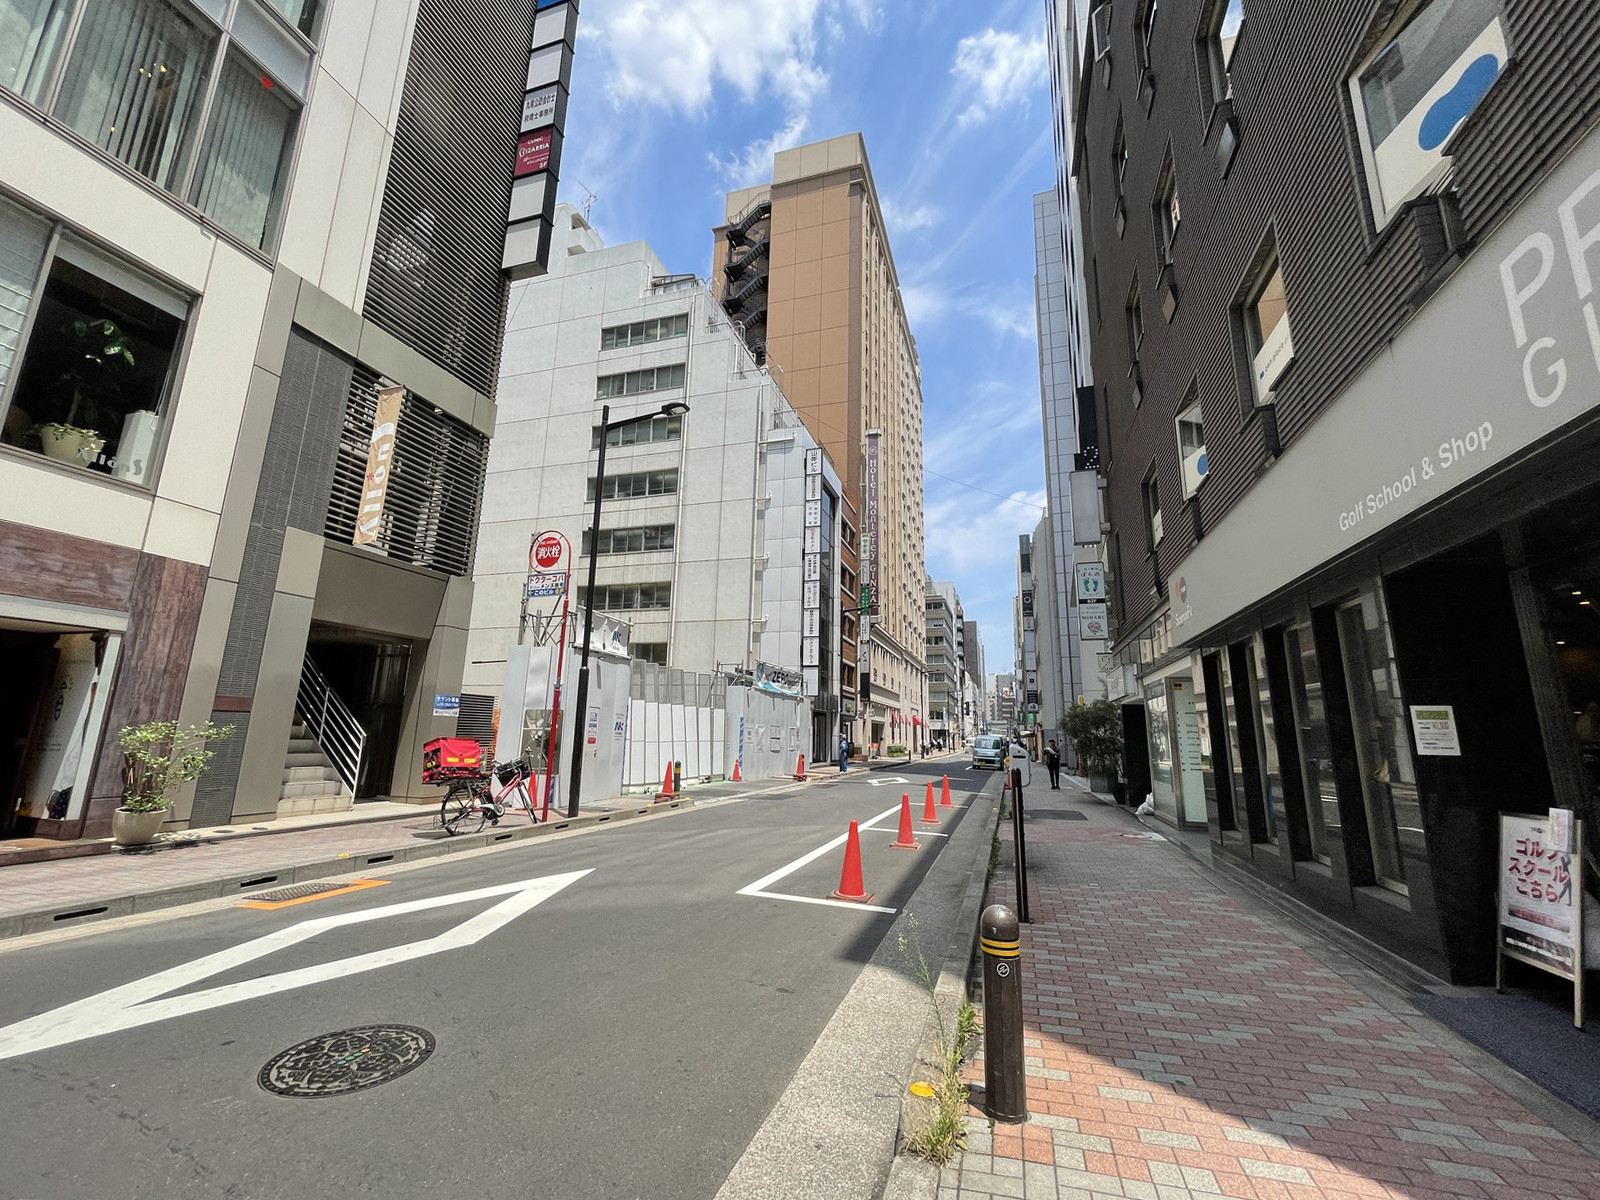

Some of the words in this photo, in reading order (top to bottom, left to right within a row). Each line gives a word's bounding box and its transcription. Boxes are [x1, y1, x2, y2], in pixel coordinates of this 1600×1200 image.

[1083, 446, 1100, 470] 2
[869, 459, 877, 497] Hotel
[1339, 501, 1364, 532] Golf
[1366, 466, 1417, 514] School
[1422, 457, 1435, 480] &
[1438, 421, 1493, 469] Shop
[869, 500, 877, 561] Monterey
[537, 545, 561, 560] 消火栓
[869, 564, 877, 603] GINZA
[1508, 856, 1570, 885] スクール
[1516, 877, 1560, 904] こちら
